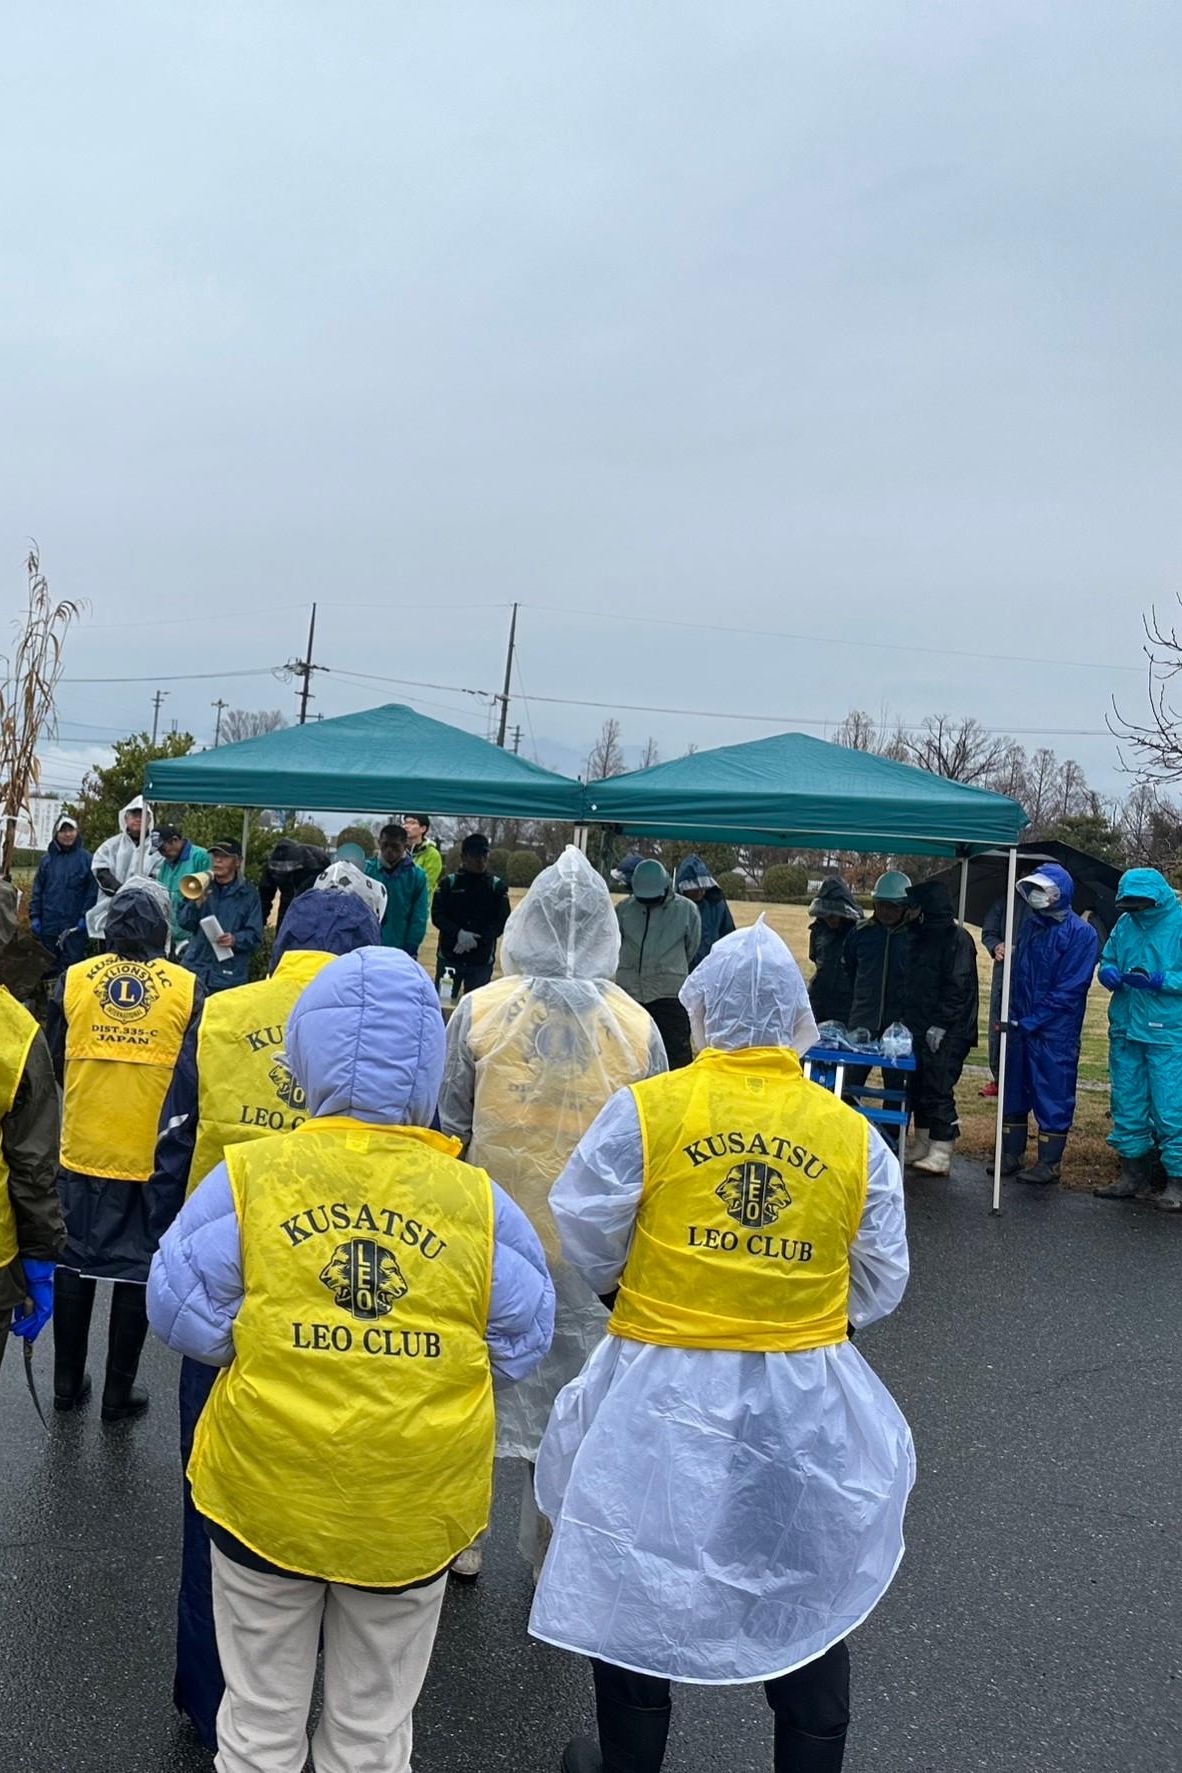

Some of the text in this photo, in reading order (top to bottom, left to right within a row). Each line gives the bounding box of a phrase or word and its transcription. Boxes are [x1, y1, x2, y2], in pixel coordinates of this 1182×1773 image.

[86, 952, 172, 988] KUSU LC
[110, 966, 147, 979] LIONS
[118, 980, 135, 1002] L
[92, 1025, 158, 1037] DIST.335-C
[97, 1034, 149, 1045] JAPAN
[240, 1105, 283, 1130] LEO
[682, 1132, 828, 1179] KUSATSU
[746, 1165, 761, 1220] LEO
[280, 1203, 447, 1259] KUSATSU
[689, 1226, 813, 1261] LEO CLUB
[357, 1243, 372, 1311] LEO
[292, 1323, 441, 1358] LEO CLUB
